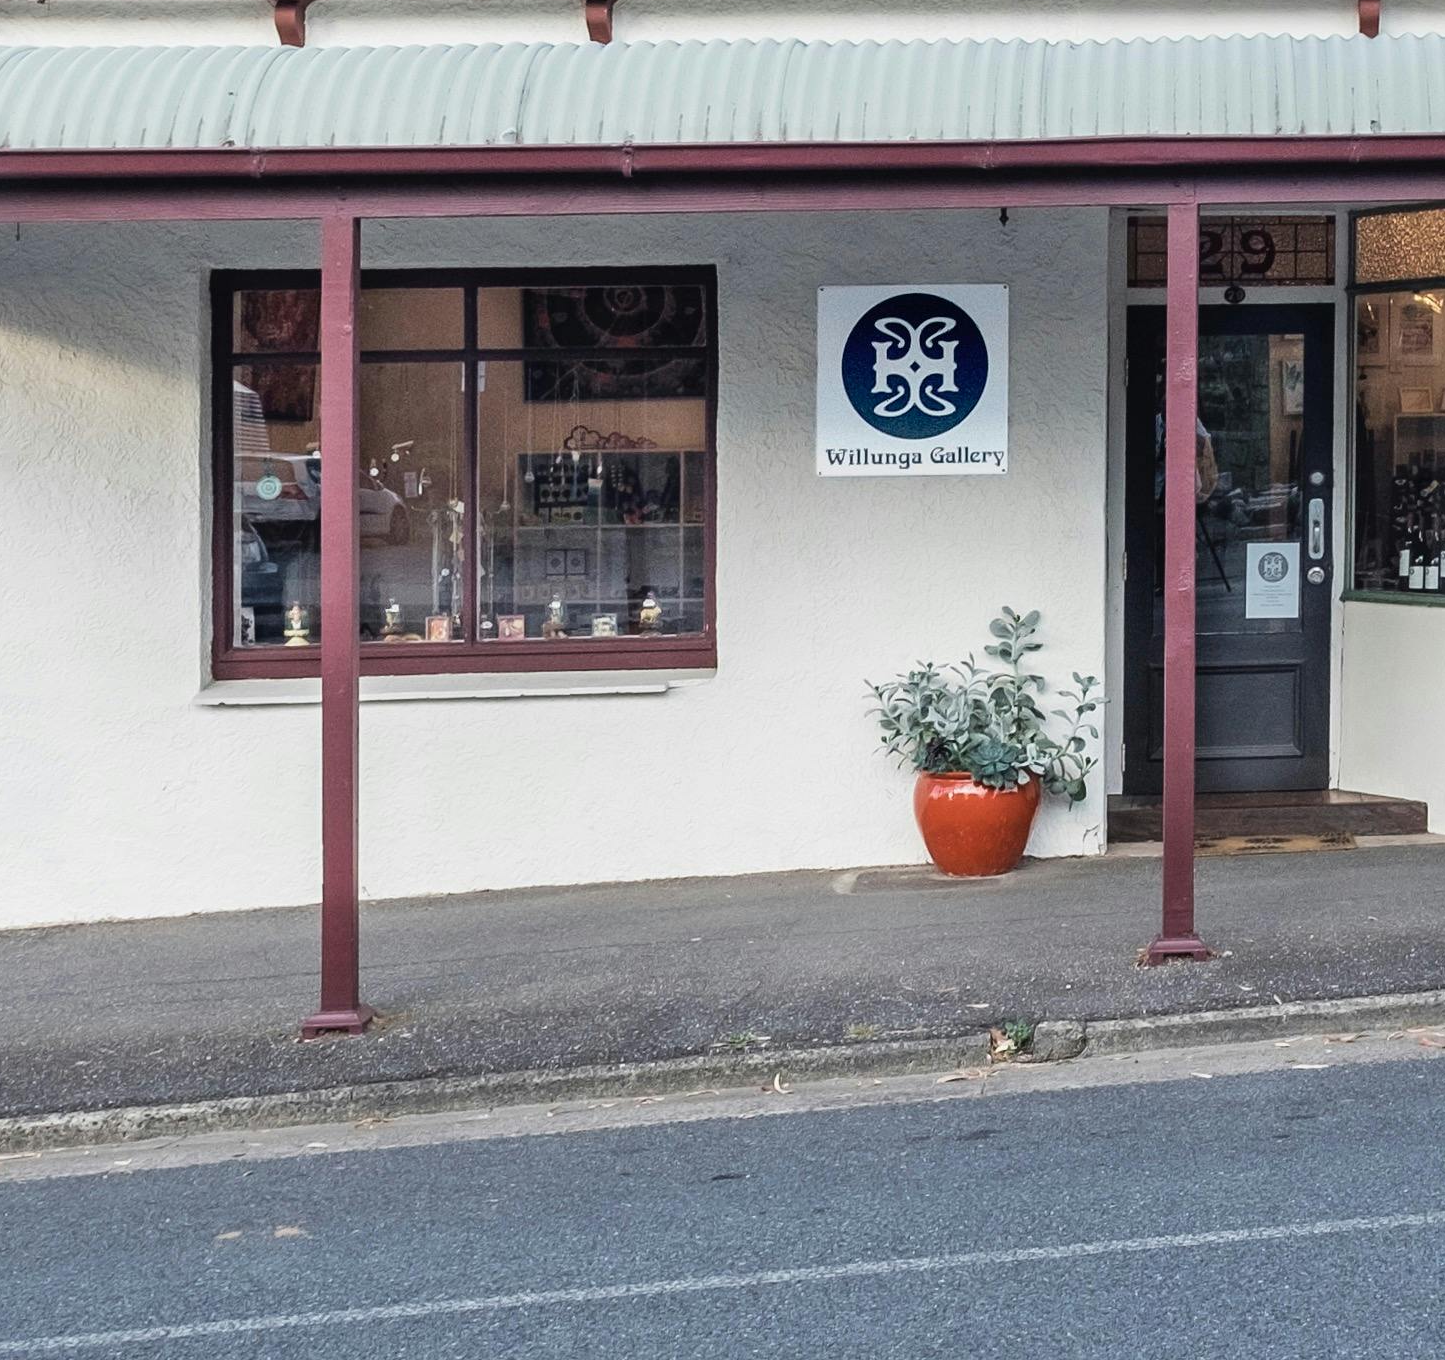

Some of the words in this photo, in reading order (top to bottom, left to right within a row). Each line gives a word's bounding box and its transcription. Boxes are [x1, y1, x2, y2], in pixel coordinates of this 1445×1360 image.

[1199, 230, 1275, 273] 29
[826, 448, 922, 469] Willunga
[930, 446, 1004, 466] Gallery
